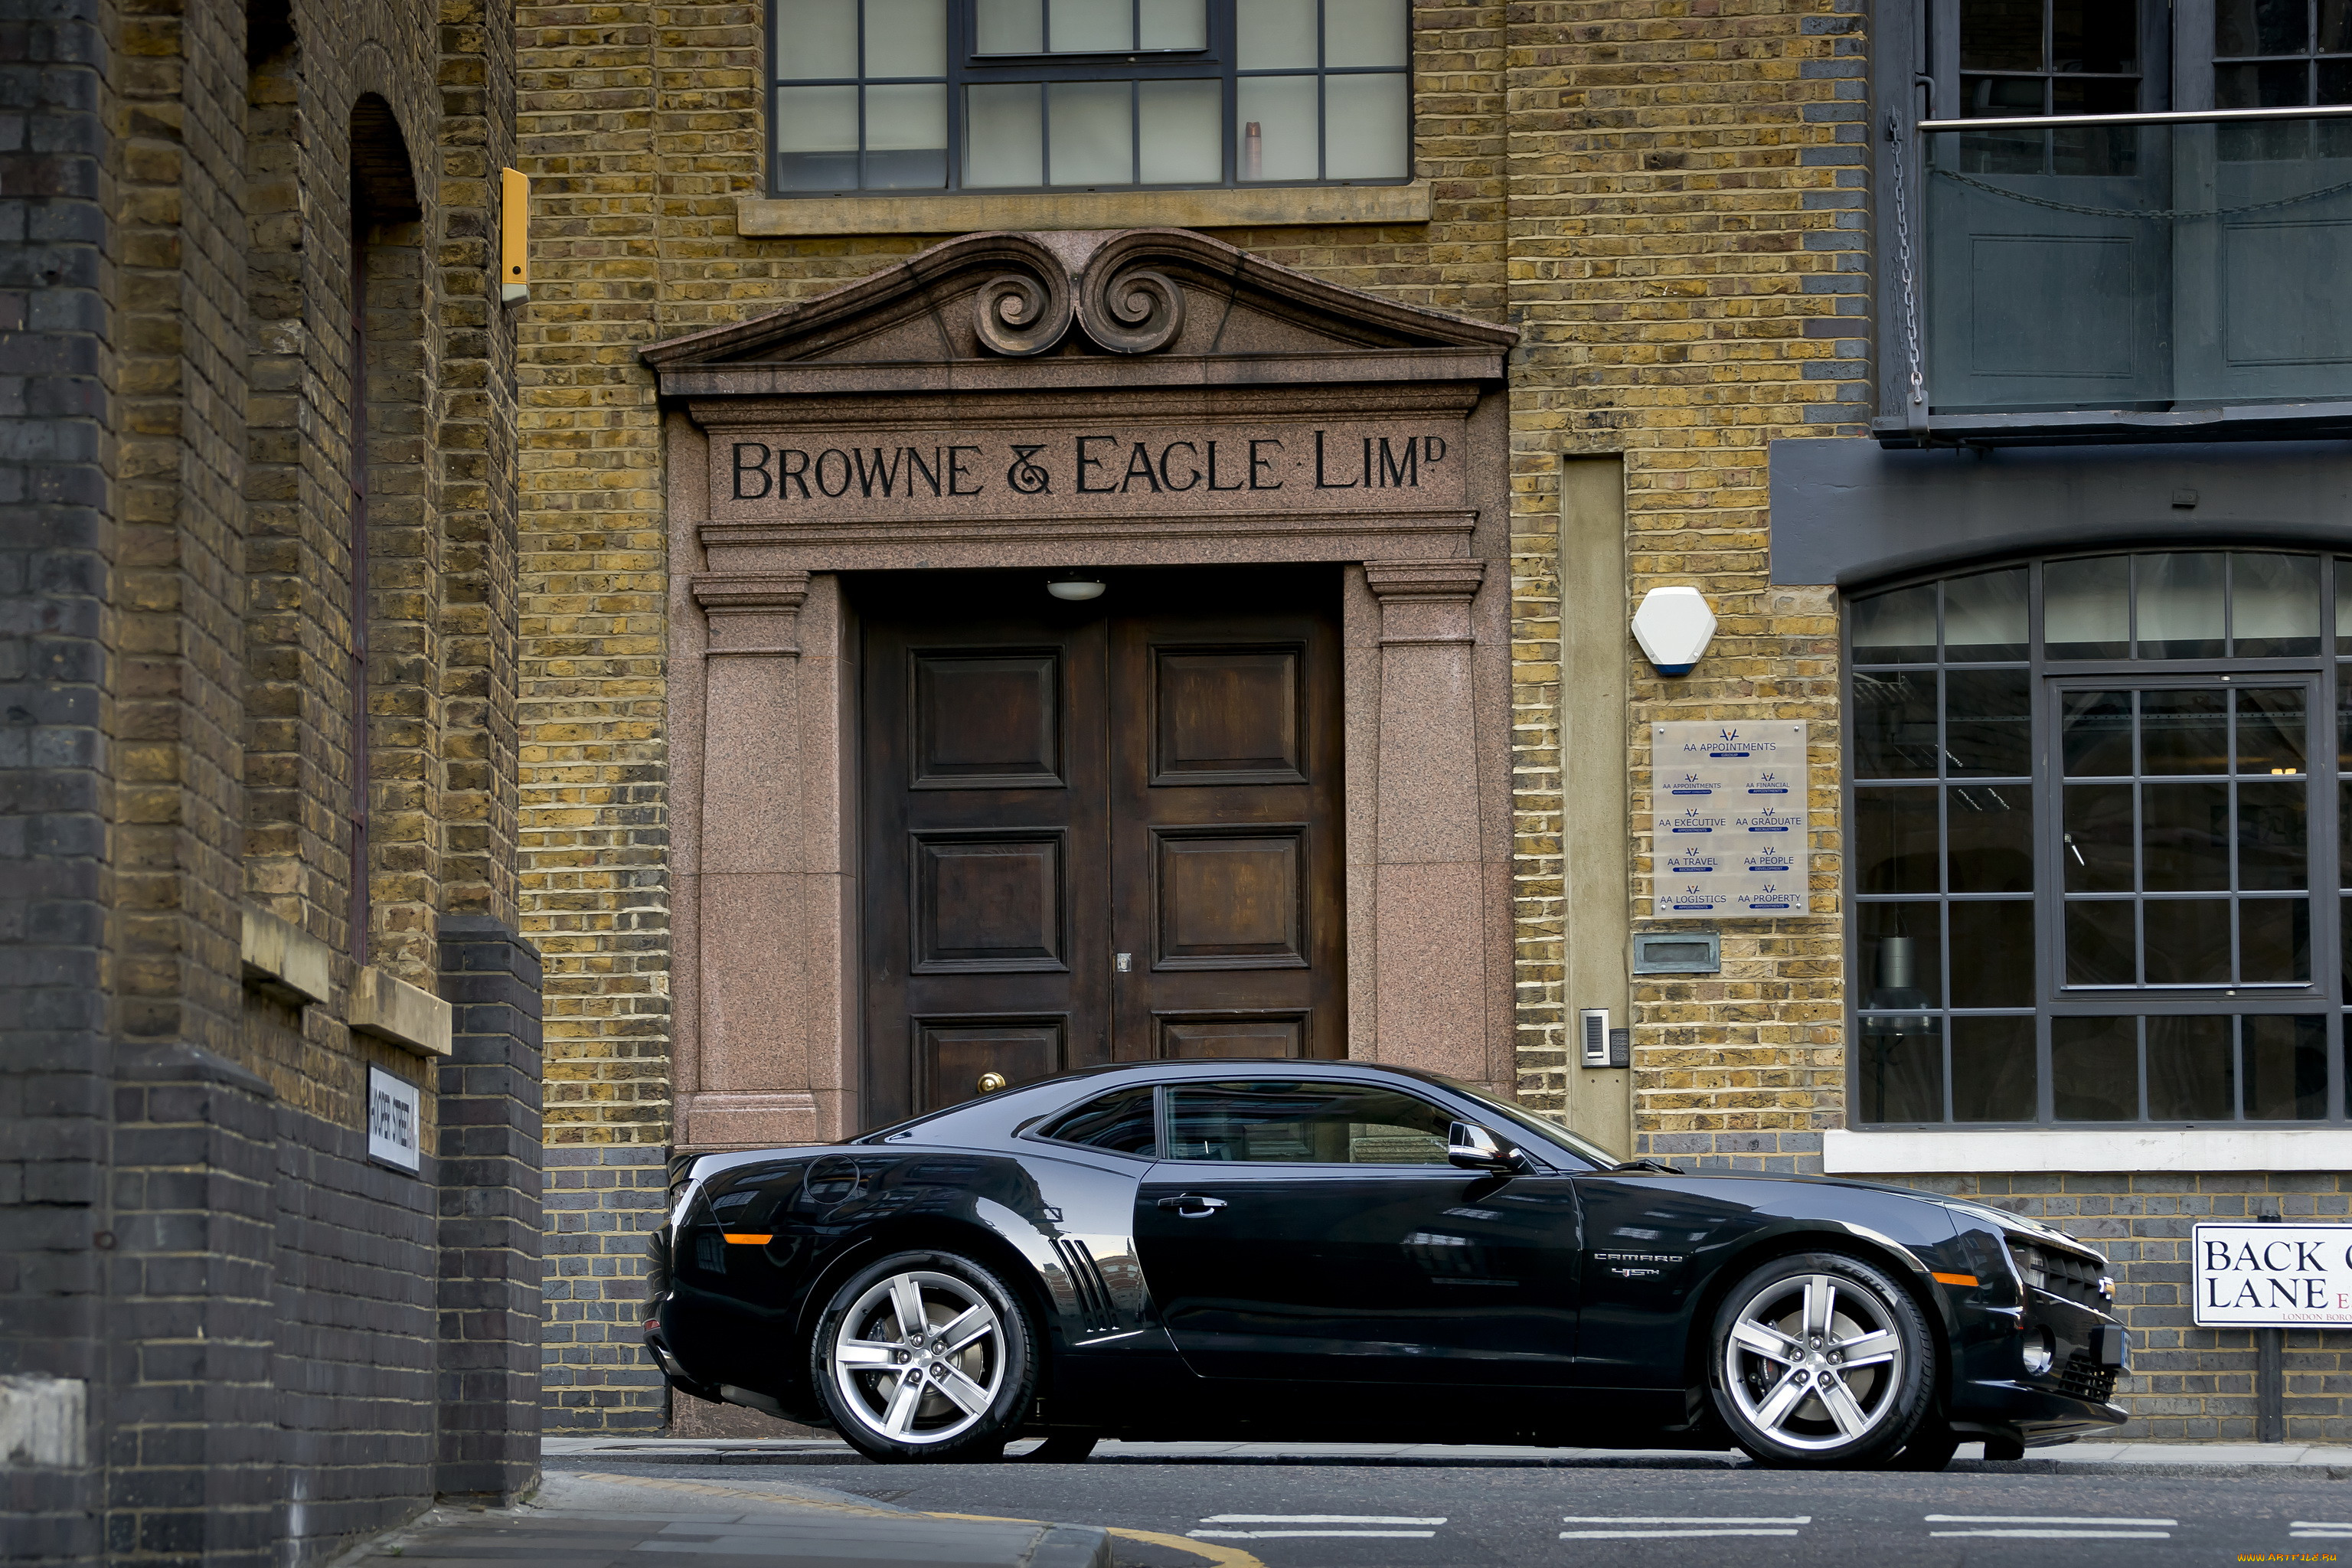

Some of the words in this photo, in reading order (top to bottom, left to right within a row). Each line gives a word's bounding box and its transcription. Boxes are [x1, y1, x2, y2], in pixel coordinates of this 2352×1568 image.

[730, 442, 985, 501] BROWNE
[1007, 444, 1054, 495] &
[1075, 435, 1285, 493] EAGLE
[1700, 743, 1776, 751] APPOINTMENTS
[1751, 817, 1802, 825] GRADUATE
[1594, 1253, 1683, 1262] CAMARO
[2203, 1240, 2328, 1272] BACK
[2205, 1277, 2329, 1308] LANE
